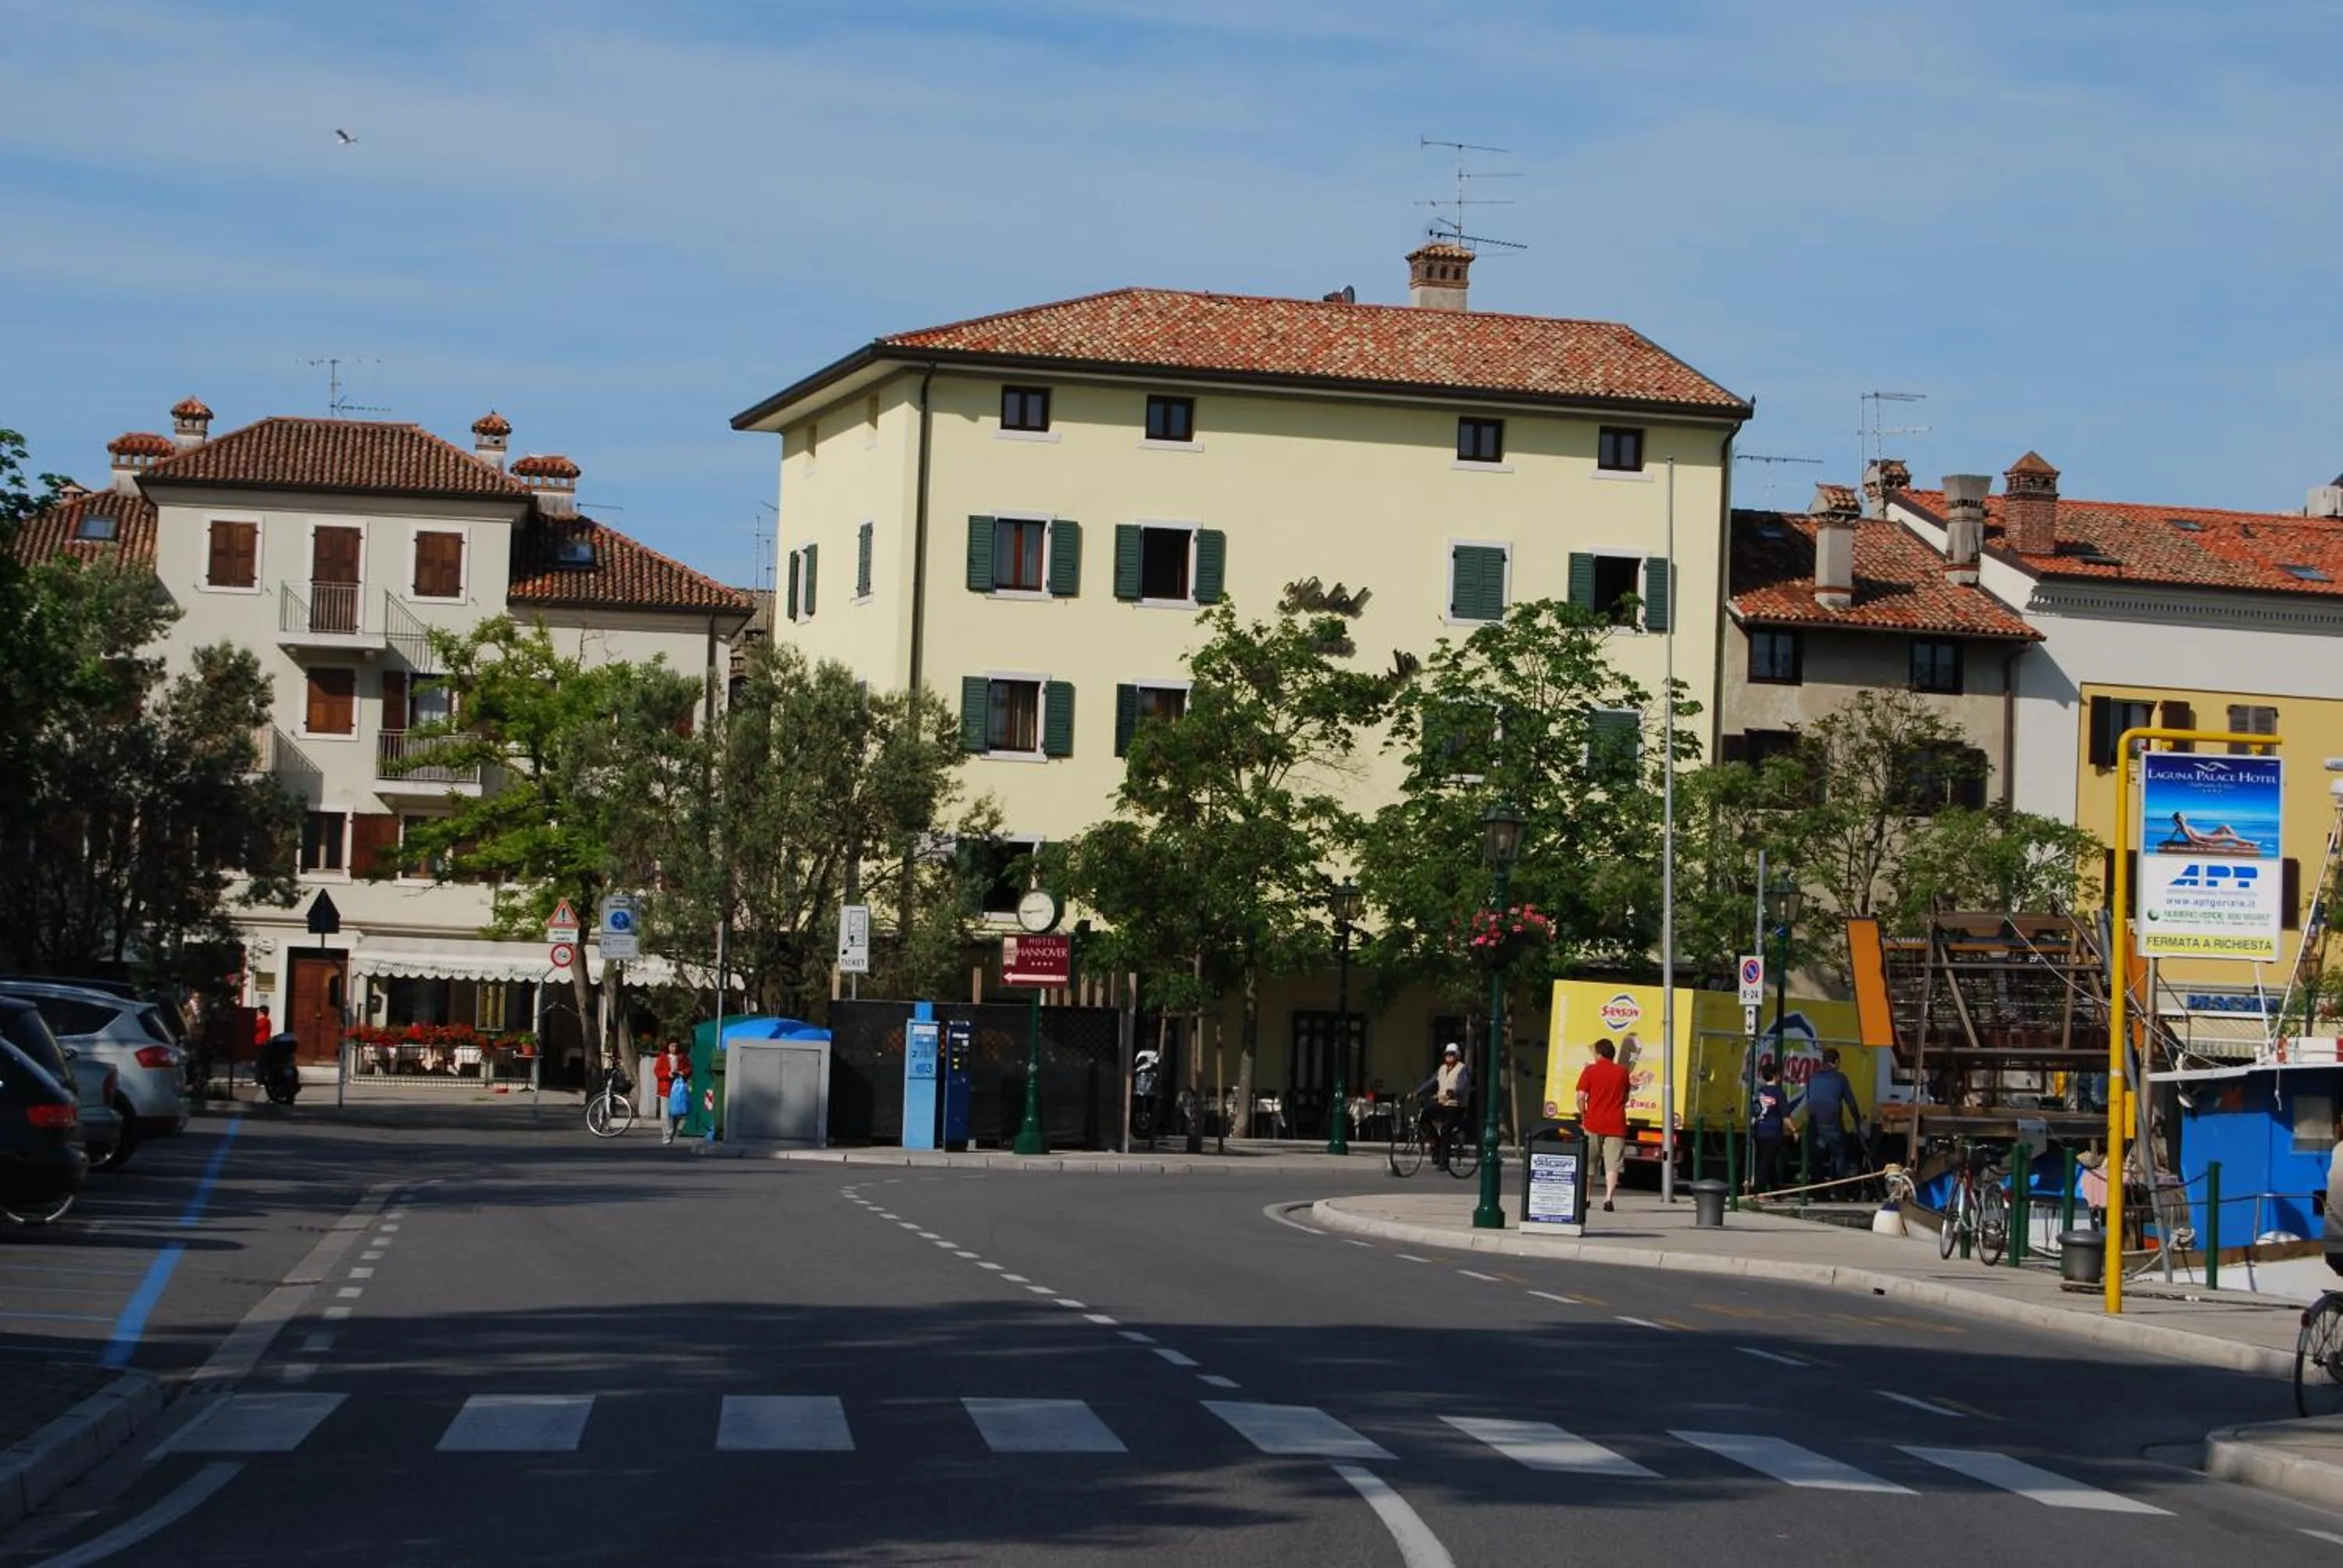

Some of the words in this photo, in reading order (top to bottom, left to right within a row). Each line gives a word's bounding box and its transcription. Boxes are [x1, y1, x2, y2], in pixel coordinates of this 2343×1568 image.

[2148, 768, 2194, 779] LAGUNA
[2196, 770, 2237, 782] PALACE
[2239, 772, 2277, 784] HOTEL
[2169, 864, 2258, 888] APT
[2166, 898, 2256, 908] www.aptgorizia.it
[2146, 936, 2200, 948] FERMATA
[2202, 939, 2211, 948] A
[2213, 939, 2273, 950] RICHIESTA
[1017, 947, 1068, 958] HANNOVER
[840, 958, 865, 967] TICKET
